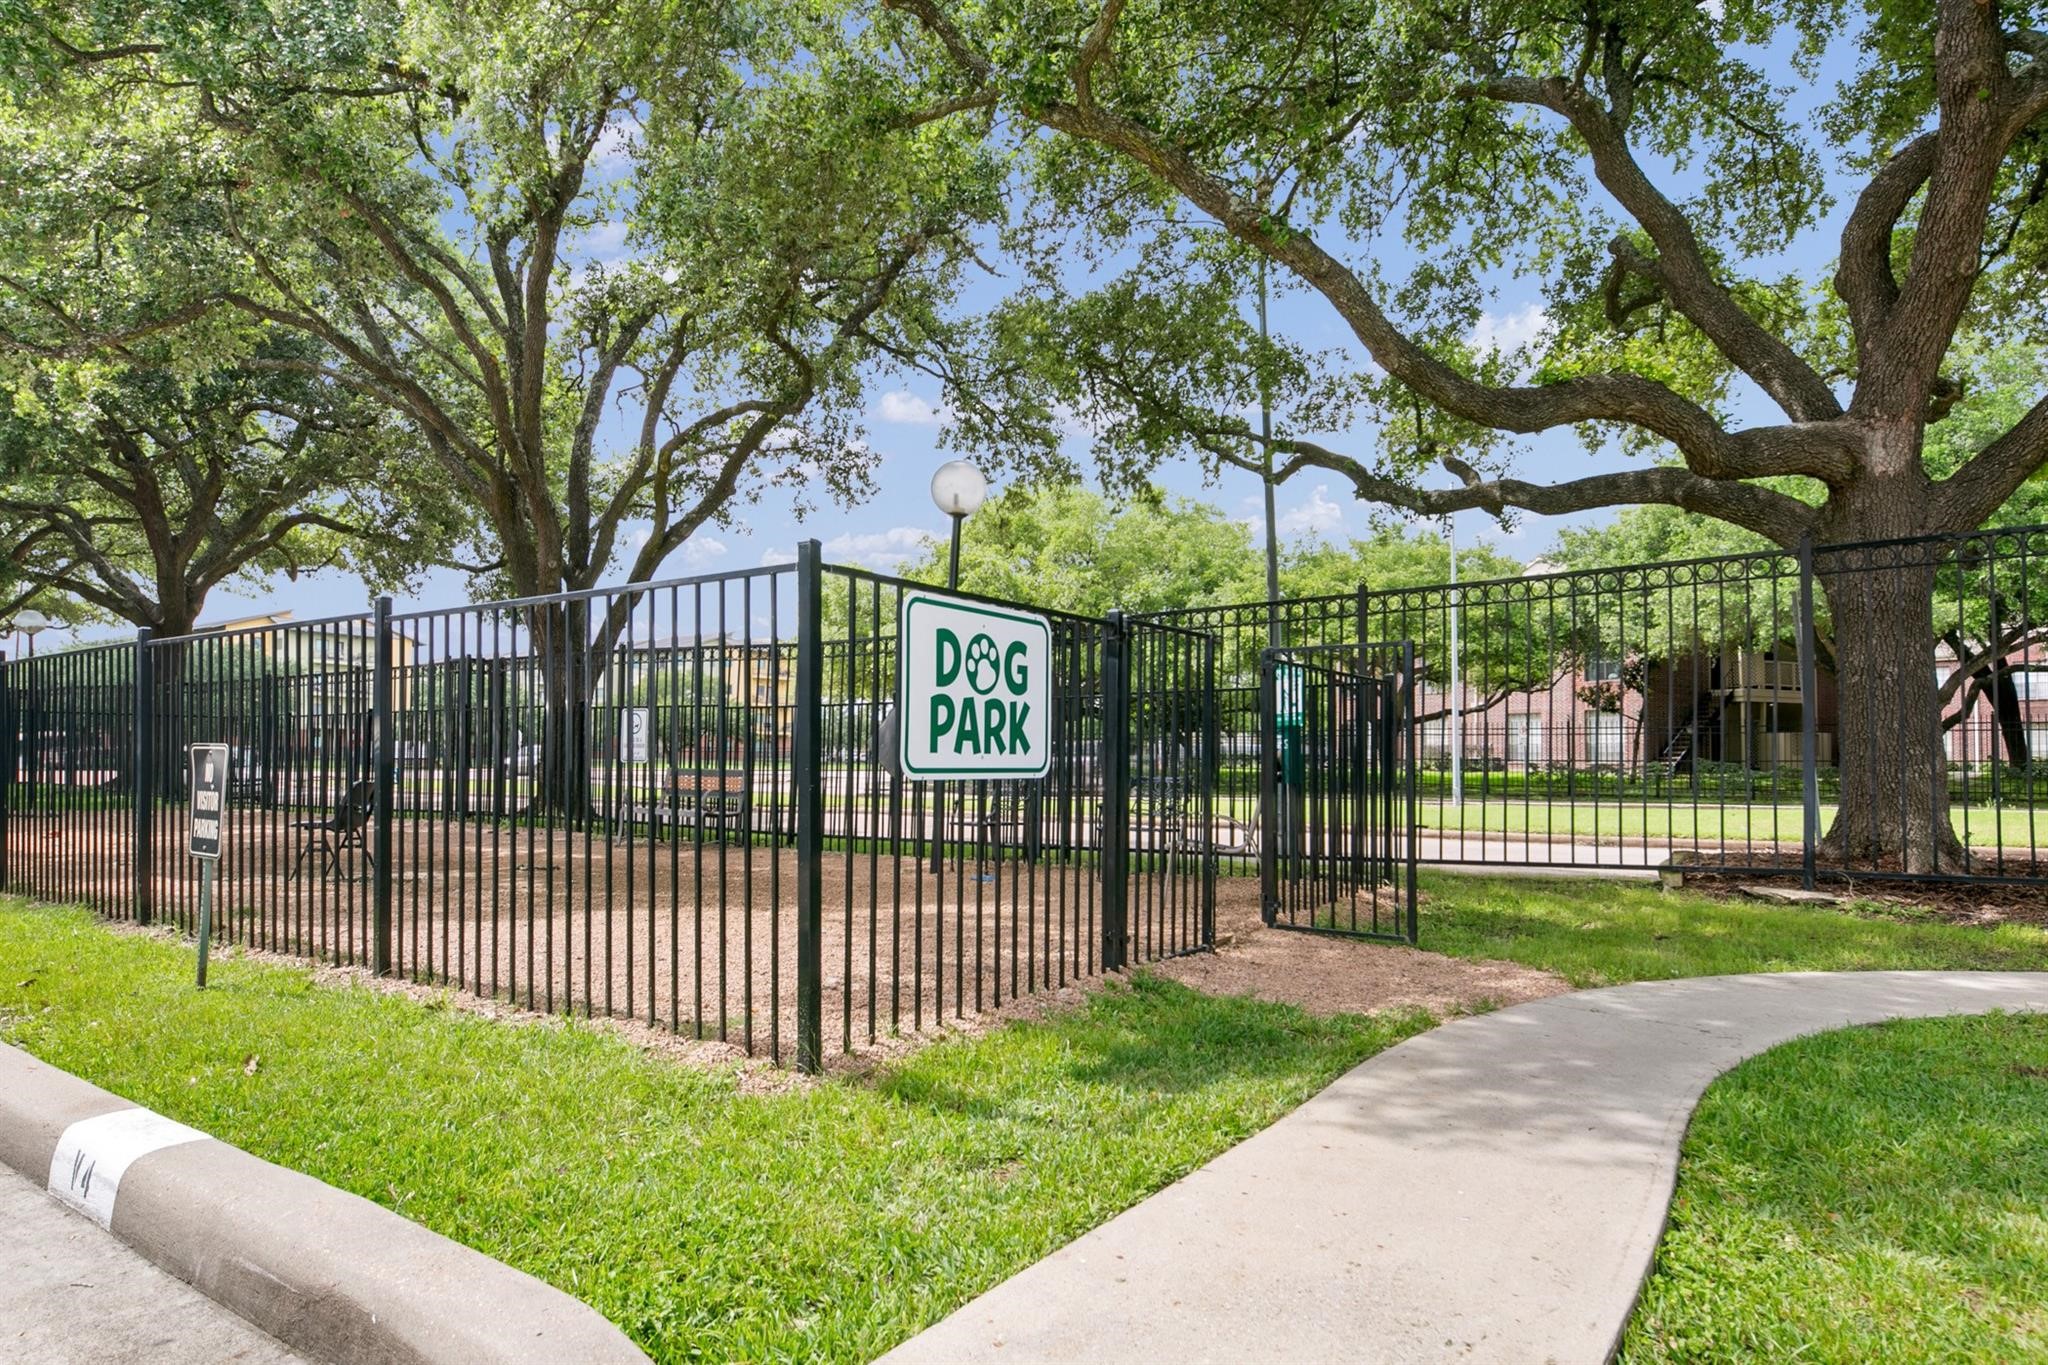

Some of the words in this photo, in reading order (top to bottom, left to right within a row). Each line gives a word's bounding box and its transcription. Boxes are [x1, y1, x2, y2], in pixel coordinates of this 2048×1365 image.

[936, 628, 1028, 696] DOG
[929, 693, 1031, 755] PARK
[196, 790, 219, 811] VISITOR
[193, 818, 219, 840] PARKING
